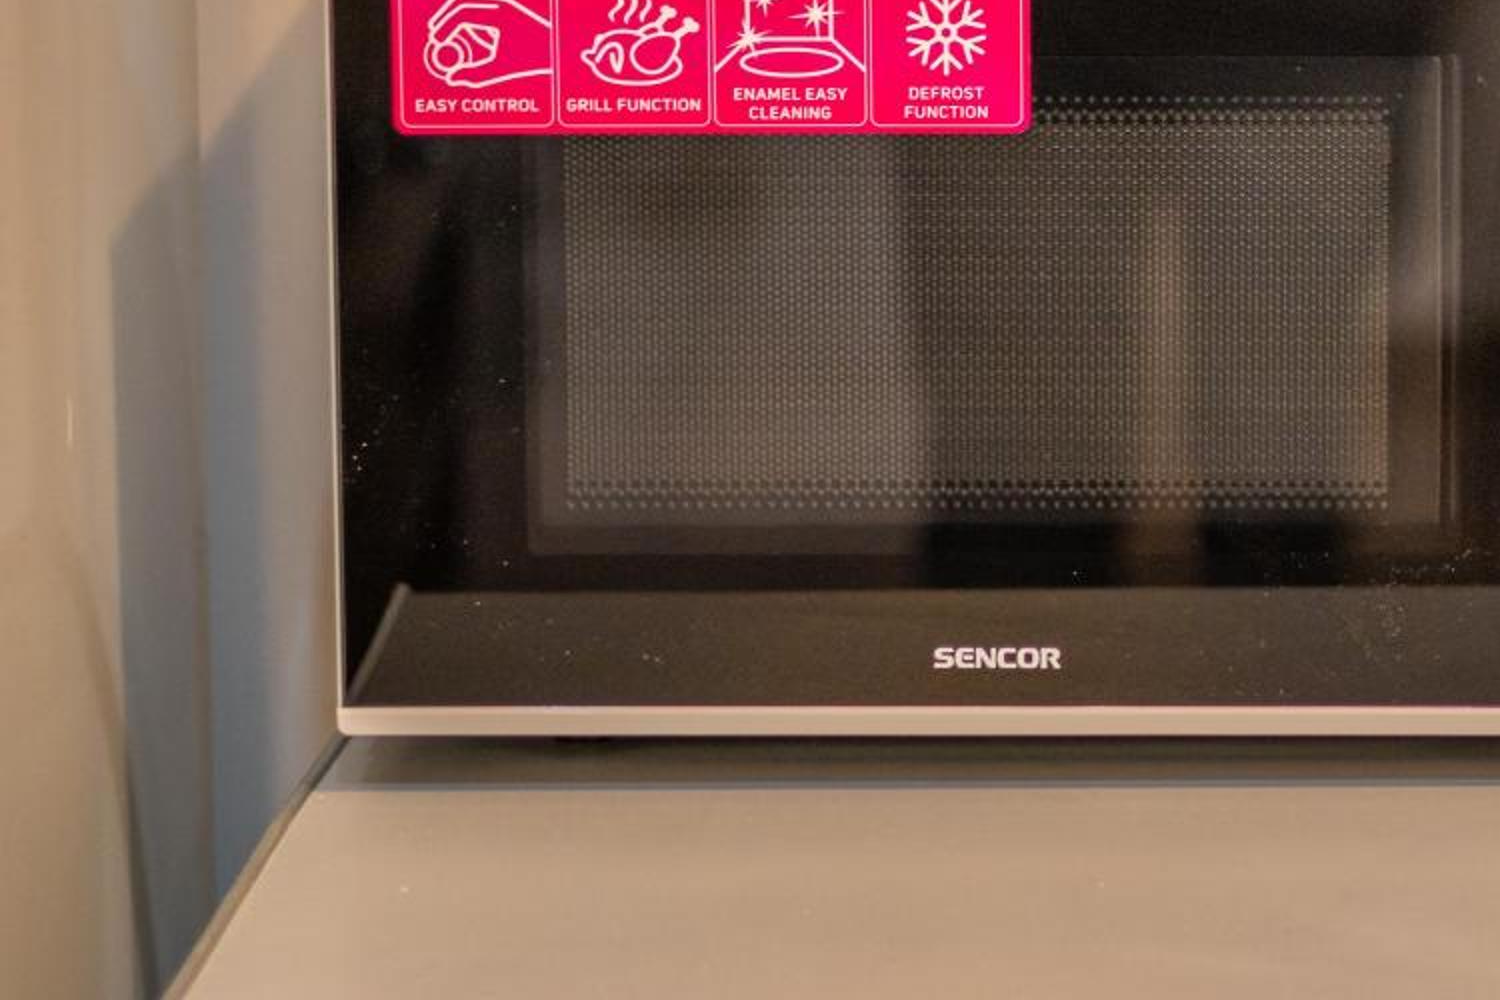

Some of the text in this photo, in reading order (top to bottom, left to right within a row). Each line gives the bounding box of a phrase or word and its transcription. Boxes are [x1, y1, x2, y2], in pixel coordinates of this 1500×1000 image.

[733, 86, 848, 102] ENAMEL EASY
[908, 86, 985, 101] DEFROST
[415, 98, 540, 113] EASY CONTROL
[566, 97, 701, 113] GRILL FUNCTION
[748, 104, 833, 121] CLEANING
[904, 104, 990, 119] FUNCTION
[933, 647, 1062, 669] SENCOR
